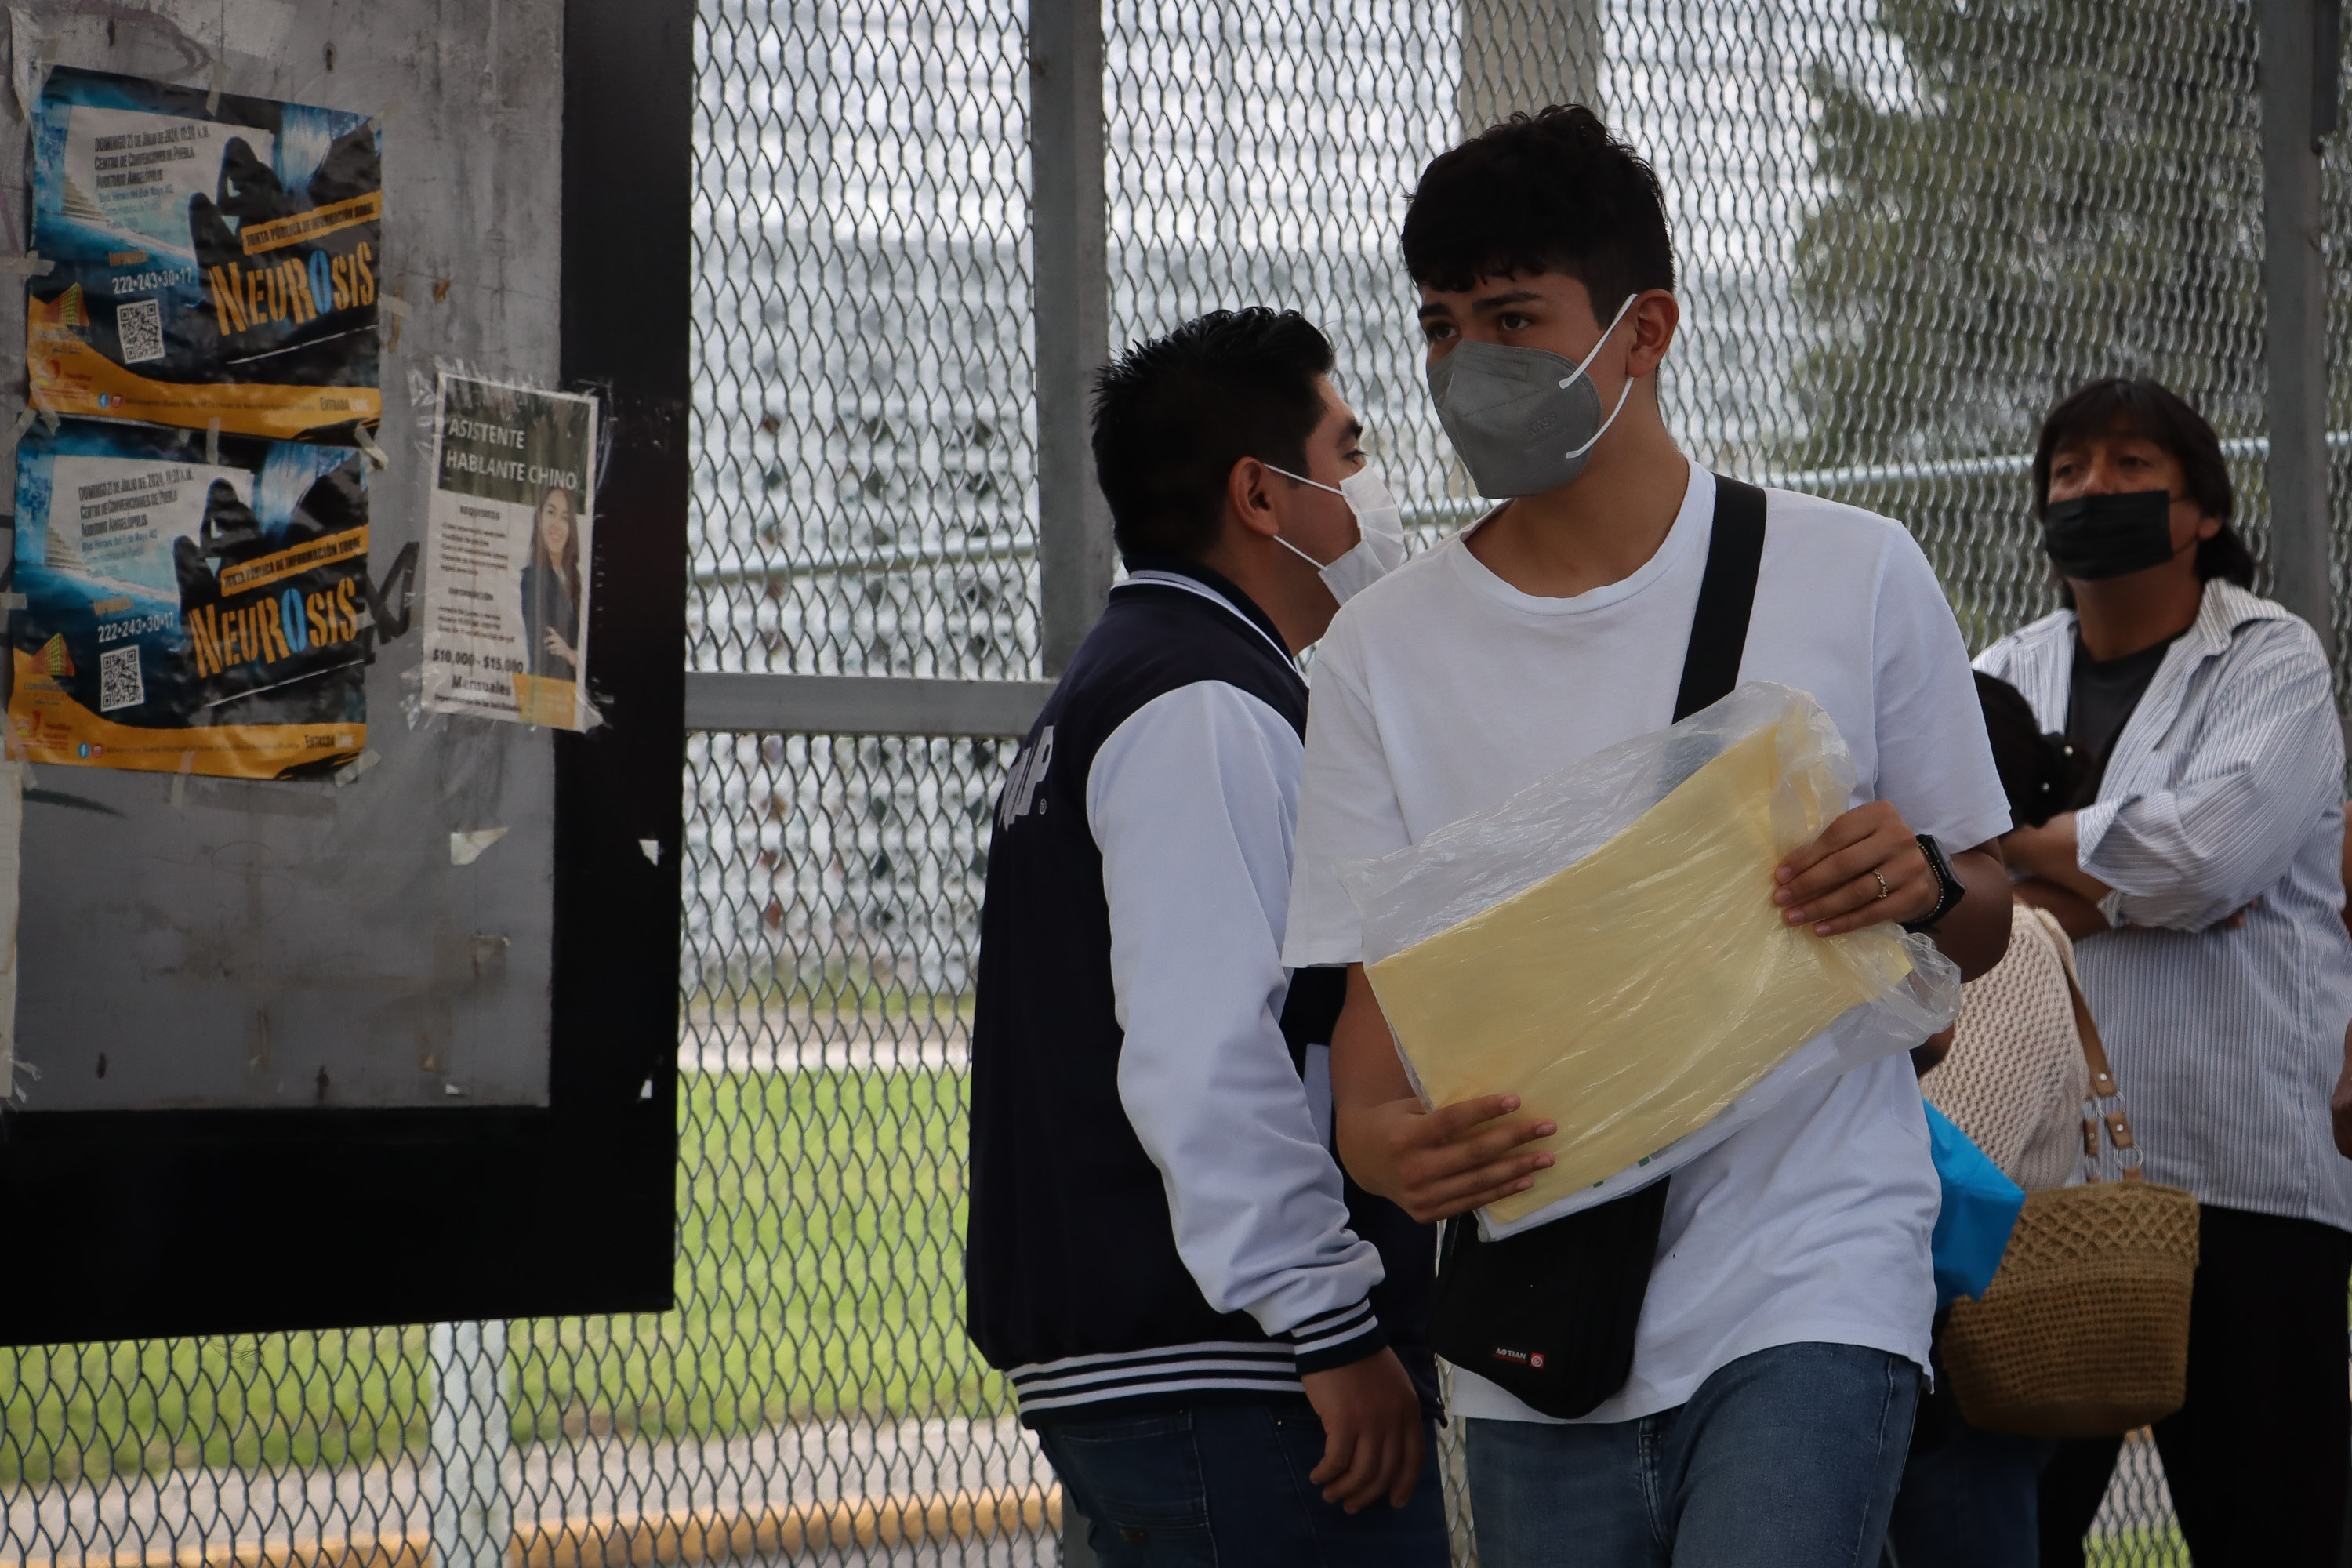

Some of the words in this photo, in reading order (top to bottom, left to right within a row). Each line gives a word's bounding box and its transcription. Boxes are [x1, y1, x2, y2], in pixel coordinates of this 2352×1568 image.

[448, 418, 525, 450] ASISTENTE
[446, 450, 524, 482] HABLANTE
[528, 463, 578, 491] CHINO
[433, 648, 475, 666] $10,000
[483, 655, 524, 673] $15,000
[452, 675, 510, 696] Mensuales
